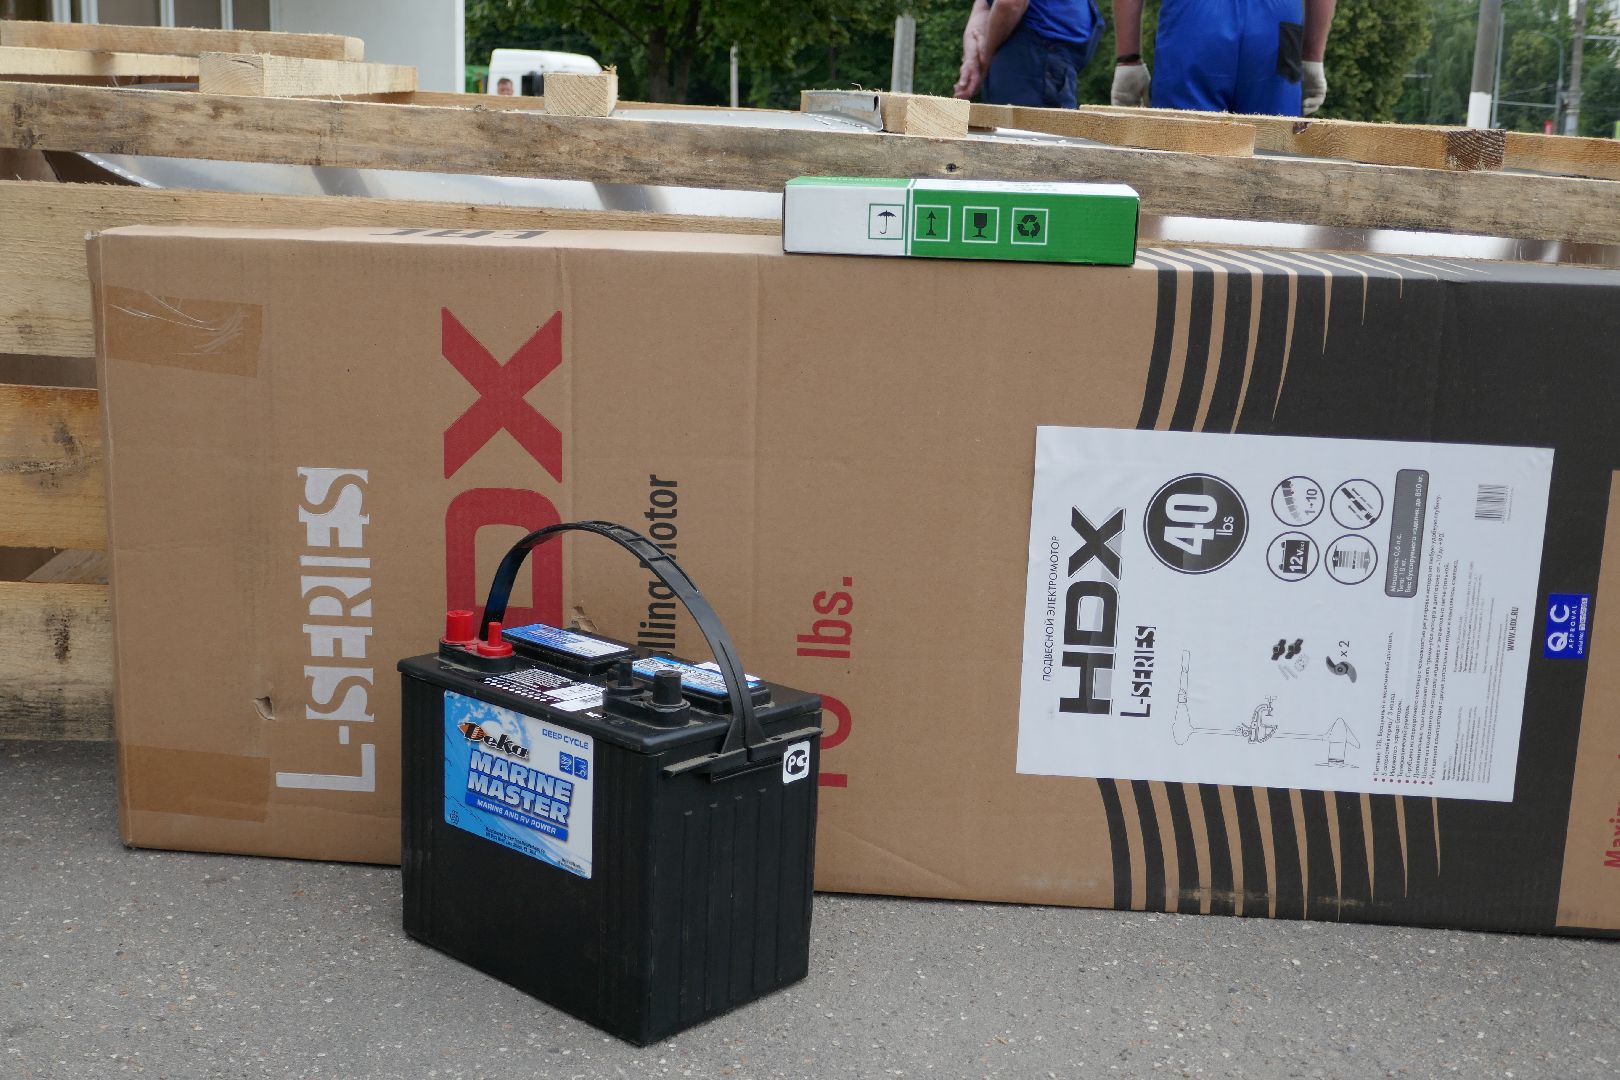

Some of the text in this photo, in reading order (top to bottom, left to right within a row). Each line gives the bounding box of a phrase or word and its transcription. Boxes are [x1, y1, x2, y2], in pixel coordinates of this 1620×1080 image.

[441, 306, 563, 629] DX
[639, 474, 678, 569] otor
[1162, 492, 1218, 555] 40
[1215, 515, 1234, 535] lbs
[275, 467, 376, 792] L-SERIES
[796, 576, 853, 659] lbs.
[1041, 535, 1060, 680] ПОДВЕСНОЙ ЭЛЕКТРОМОТОР
[1058, 505, 1125, 715] HDX
[1568, 605, 1578, 649] APPROVAL
[1119, 625, 1156, 717] L-SERIES
[542, 728, 590, 750] DEEP CYCLE
[467, 771, 569, 825] MASTER
[471, 750, 573, 803] MARINE
[477, 799, 503, 816] MARINE
[504, 807, 520, 821] AND
[530, 816, 557, 835] POWER
